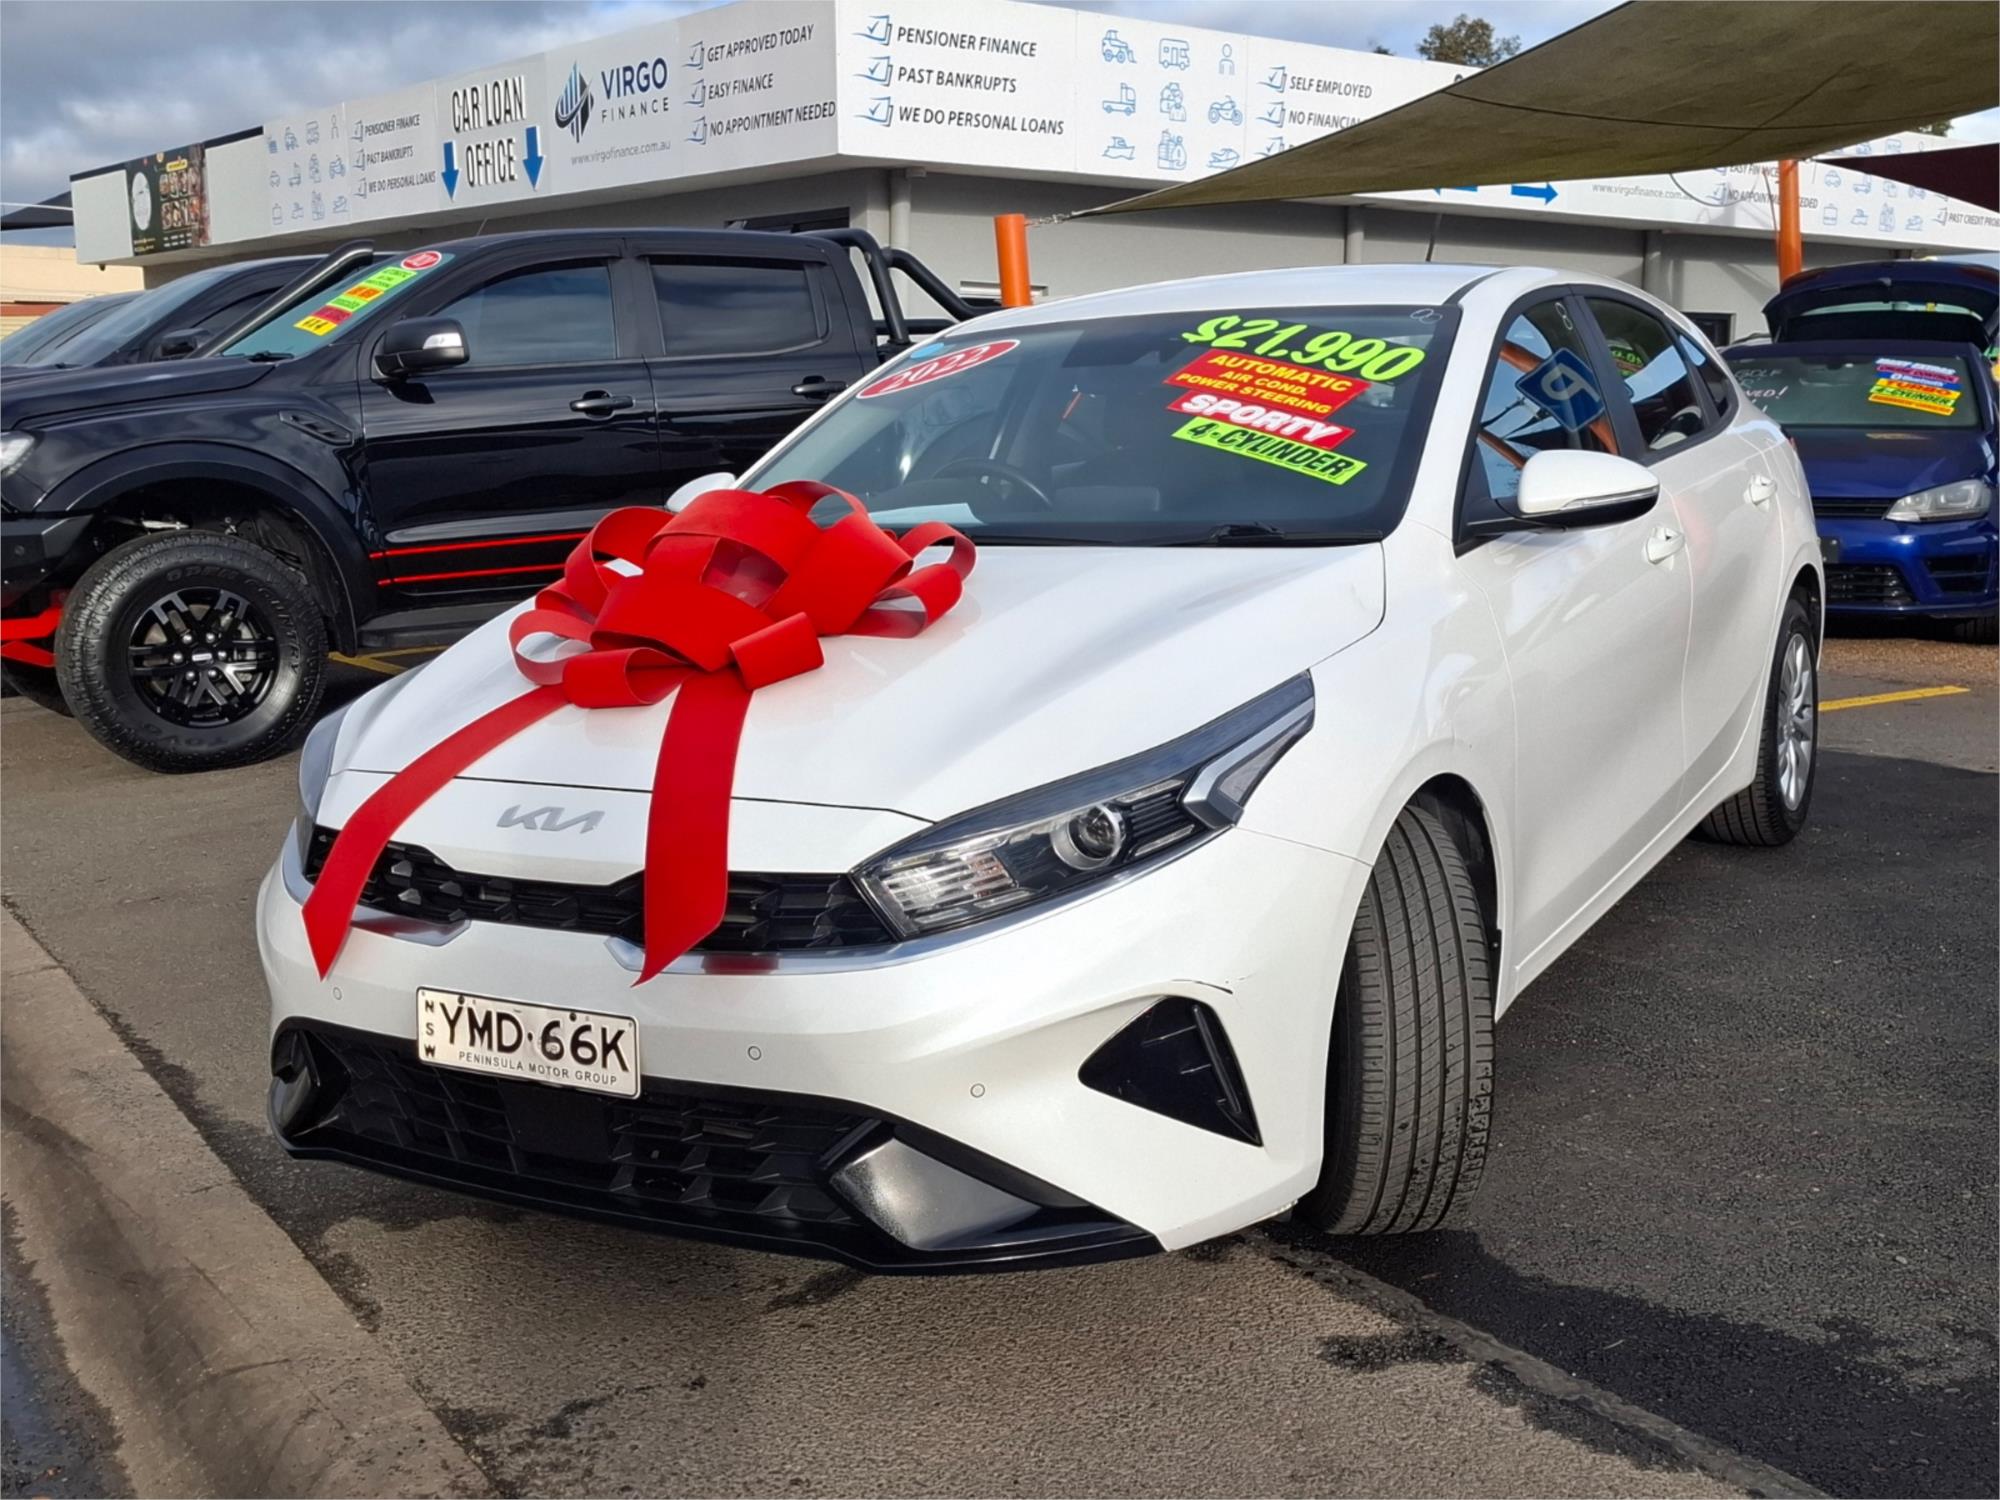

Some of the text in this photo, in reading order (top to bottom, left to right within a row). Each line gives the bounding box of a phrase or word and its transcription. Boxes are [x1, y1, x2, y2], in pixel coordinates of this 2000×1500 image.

[707, 24, 814, 62] GET APPROVED TODAY
[897, 26, 1037, 57] PENSIONER FINANCE
[601, 57, 667, 100] VIRGO
[709, 73, 773, 100] EASY FINANCE
[898, 66, 1016, 93] PAST BANKRUPTS
[1290, 76, 1373, 99] SELF EMPLOYED
[452, 76, 526, 133] CAR LOAN
[602, 97, 669, 123] FINANCE
[710, 101, 836, 136] NO APPOINTMENT NEEDED
[1288, 110, 1306, 125] NO
[365, 114, 420, 136] PENSIONER FINANCE
[899, 106, 1064, 135] WE DO PERSONAL LOANS
[366, 146, 413, 165] PAST BANKRUPTS
[466, 138, 518, 188] OFFICE
[571, 141, 671, 165] www.virgofinance.com.au
[879, 345, 991, 394] 2022
[1207, 354, 1353, 392] AUTOMATIC
[1219, 370, 1307, 396] AIR COND.
[1176, 373, 1333, 414] POWER STEERING
[1181, 393, 1343, 443] SPORTY
[1187, 421, 1354, 478] 4-CYLINDER
[496, 804, 605, 834] KIA
[458, 1050, 618, 1086] PENINSULA MOTOR GROUP
